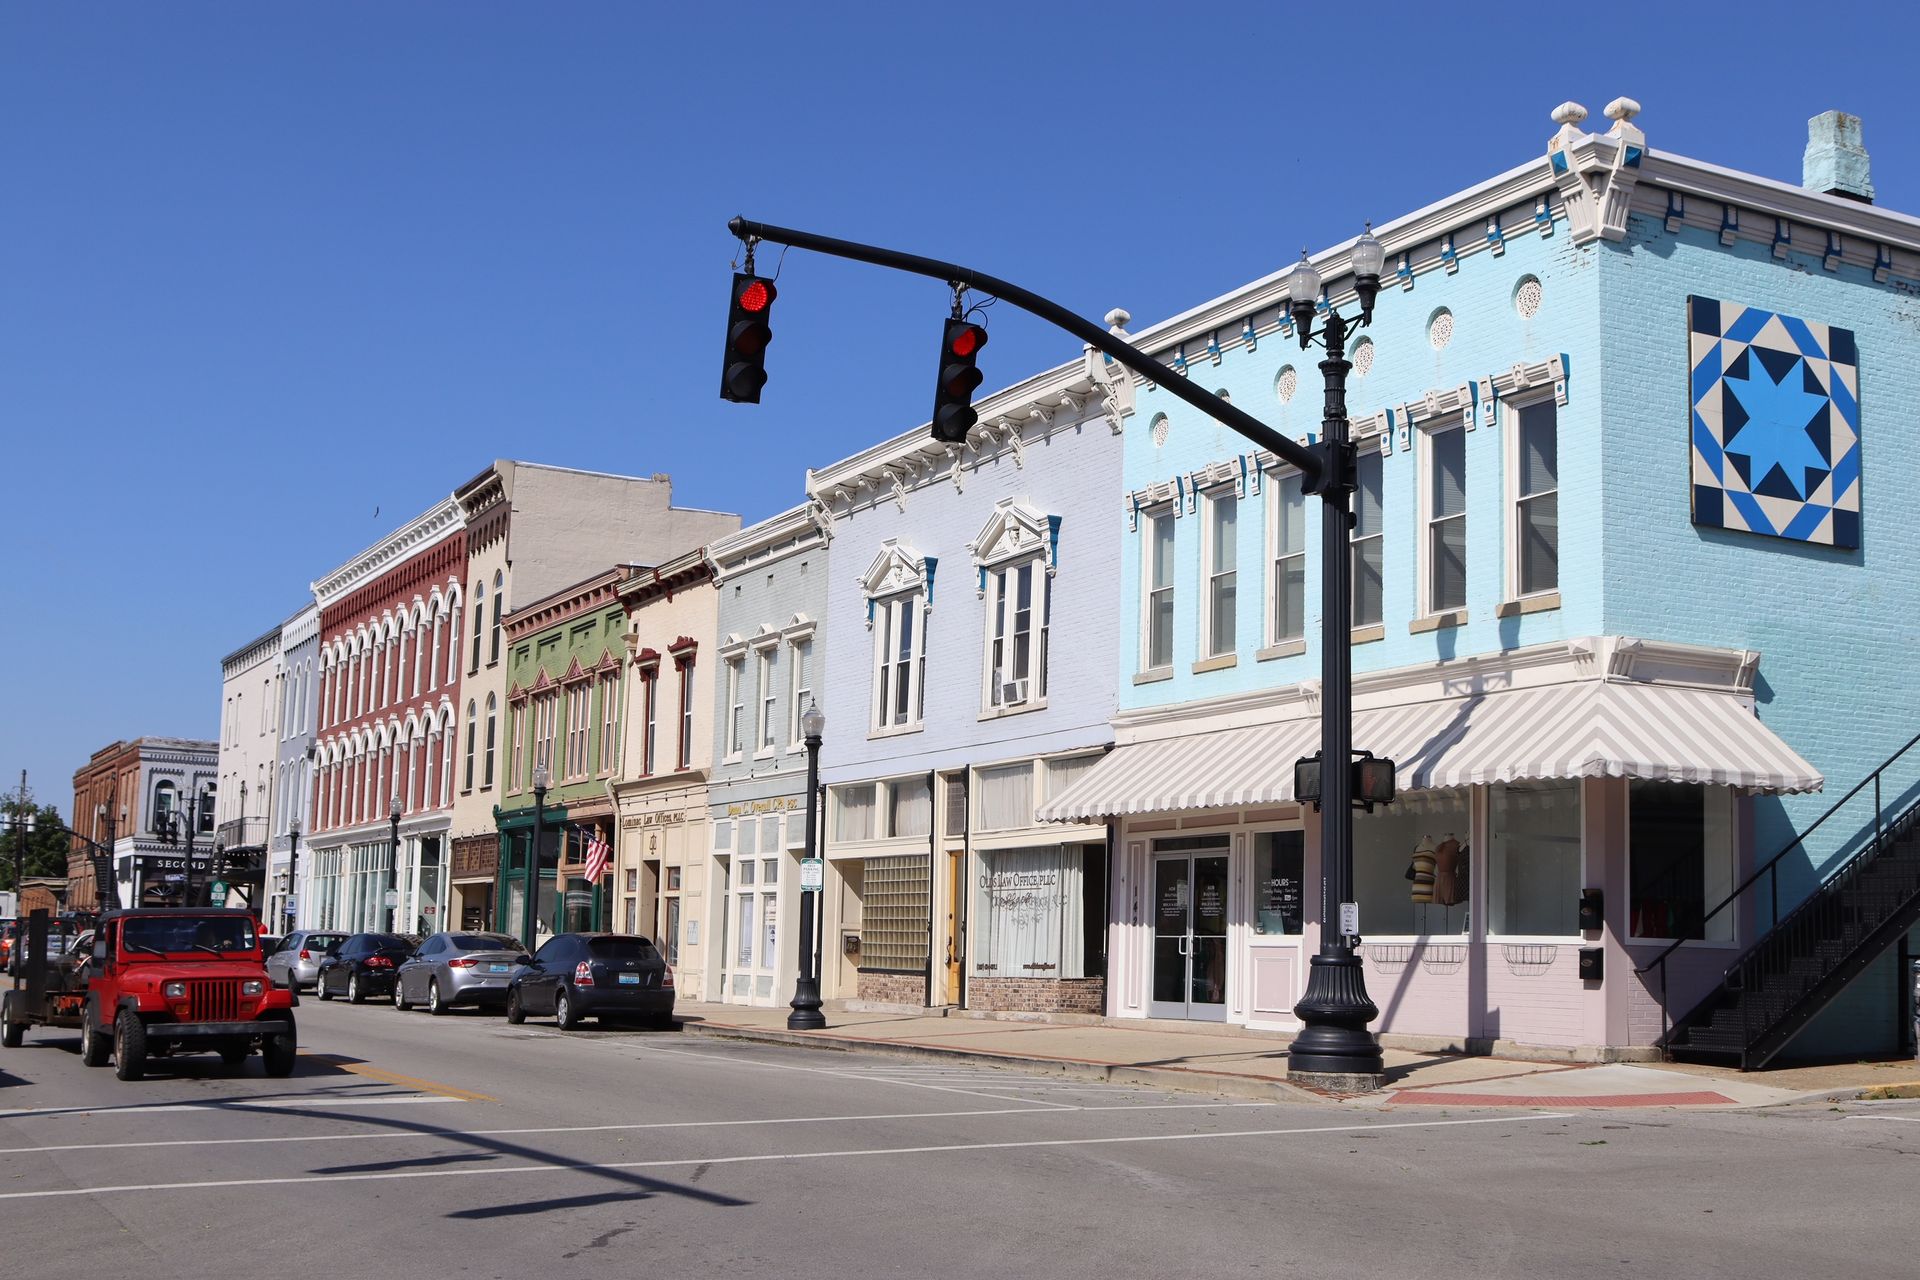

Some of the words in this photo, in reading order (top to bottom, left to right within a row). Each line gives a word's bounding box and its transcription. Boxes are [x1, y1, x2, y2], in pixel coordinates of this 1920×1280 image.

[644, 814, 653, 825] Law
[1039, 874, 1056, 886] PLLC
[1271, 878, 1289, 887] HOURS
